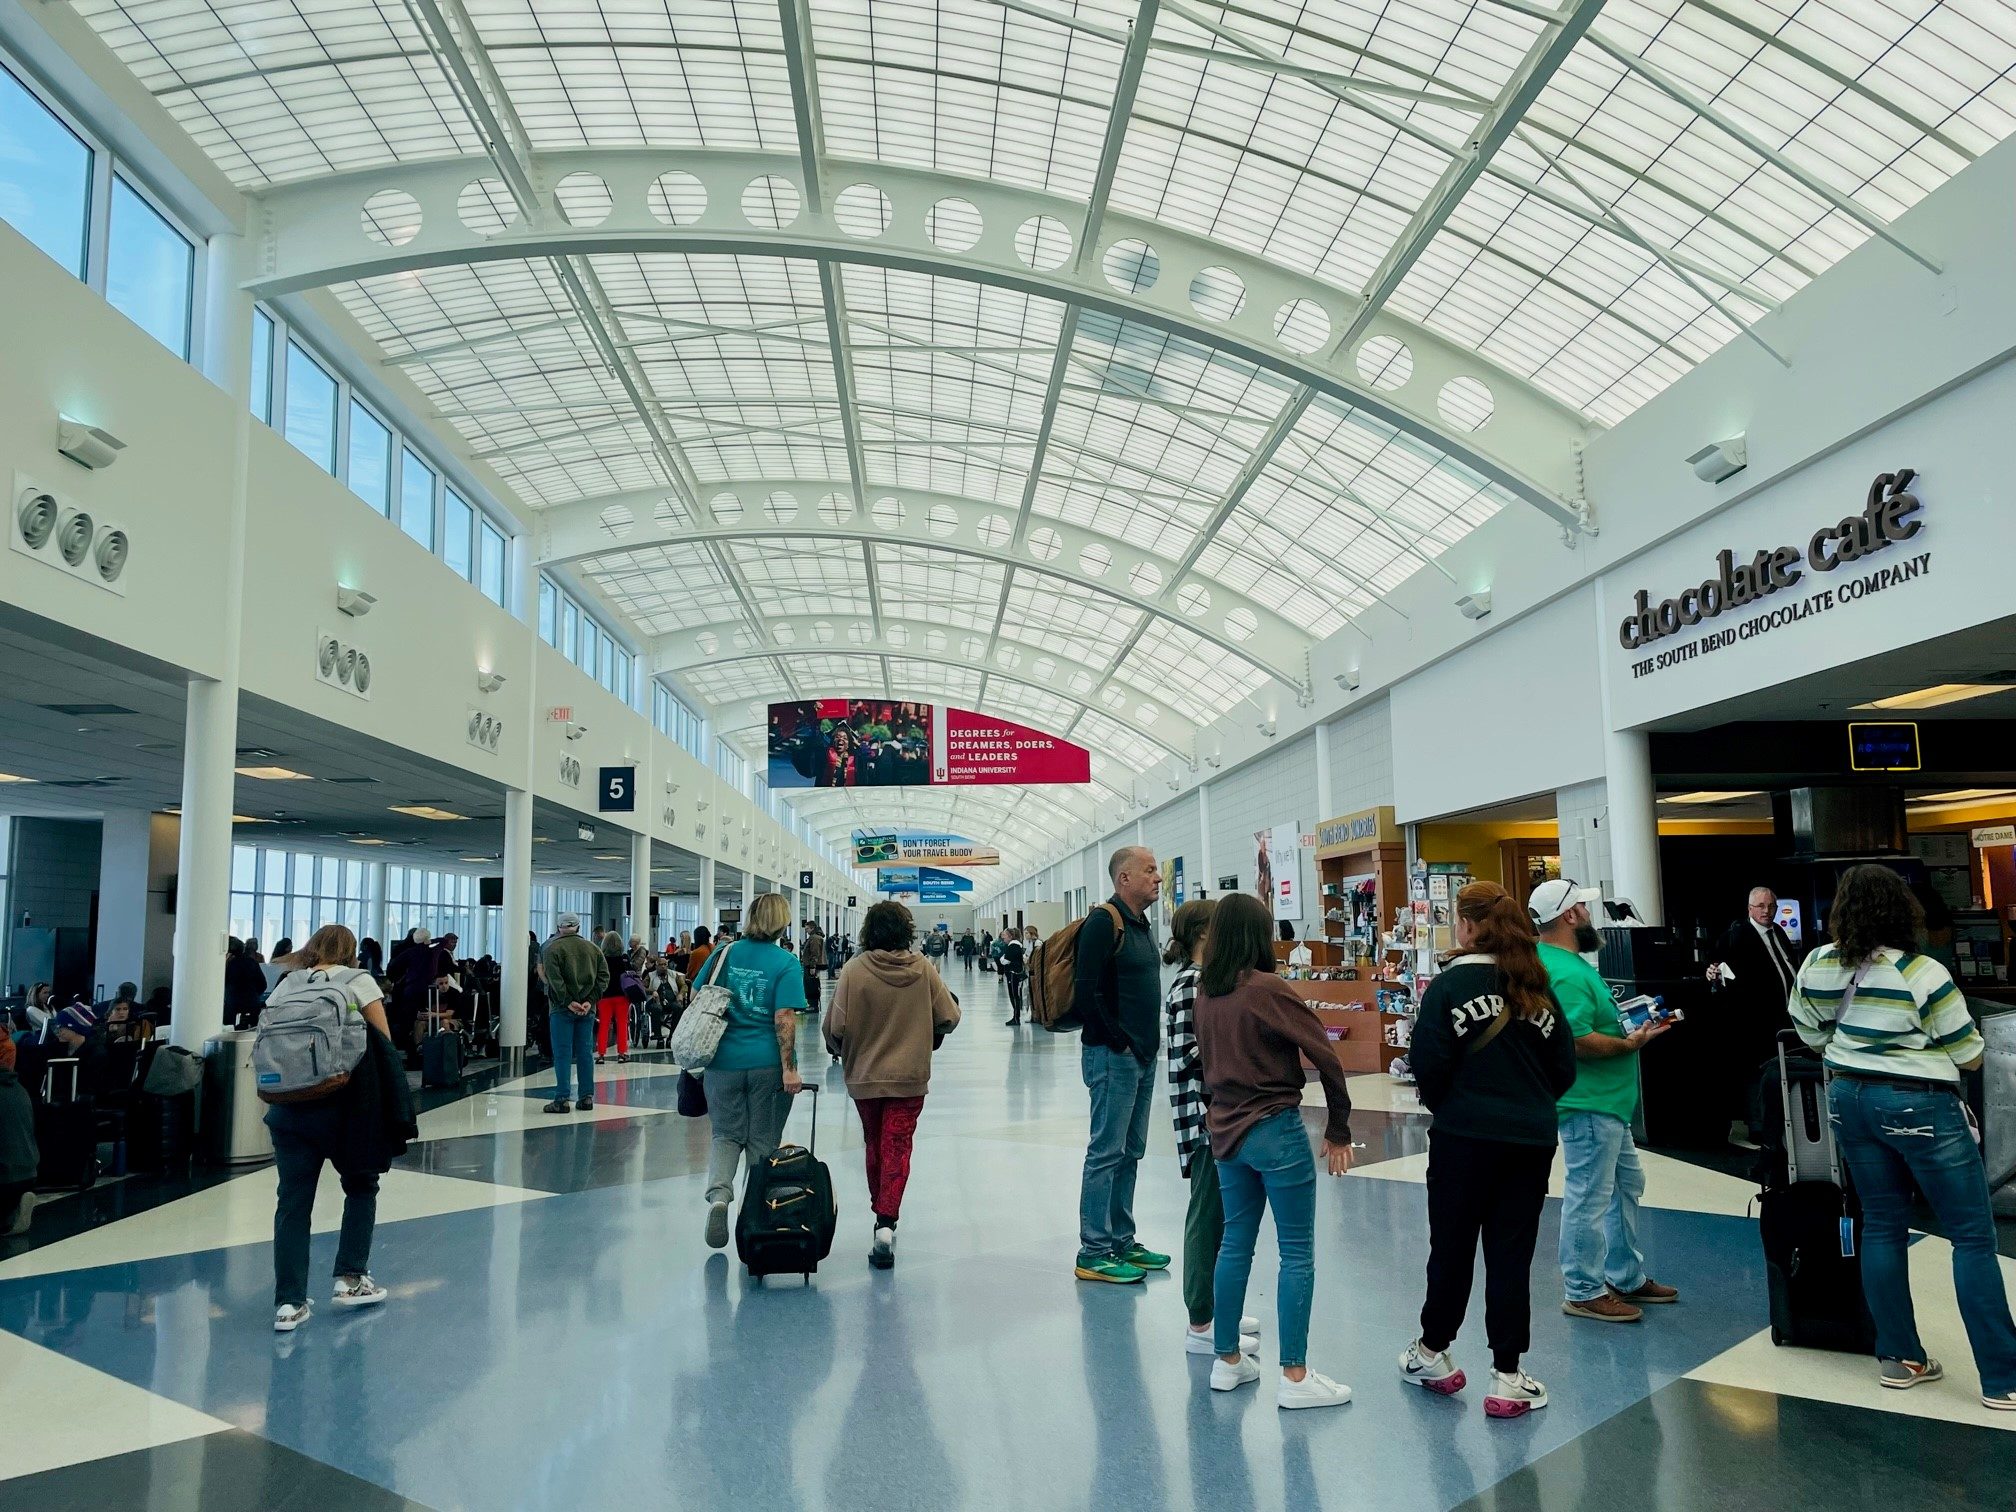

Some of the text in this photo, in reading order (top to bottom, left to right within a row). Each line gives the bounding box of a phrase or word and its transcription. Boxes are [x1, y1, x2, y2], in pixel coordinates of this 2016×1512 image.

[1620, 468, 1921, 650] chocolate café
[1631, 552, 1931, 679] THE SOUTH BEND CHOCOLATE COMPANY
[553, 708, 569, 720] EXIT
[950, 729, 1015, 738] DEGREES for
[950, 740, 1055, 750] DREAMERS, DOERS,
[968, 752, 1018, 761] LEADERS
[978, 766, 1017, 774] UNIVERSITY
[609, 777, 624, 799] 5
[1335, 823, 1350, 844] BEND
[1995, 831, 2013, 841] DAME
[903, 838, 951, 847] DON'T FORGET
[903, 849, 921, 858] YOUR
[923, 849, 949, 857] TRAVEL
[950, 848, 973, 857] BUDDY
[803, 875, 810, 884] 6
